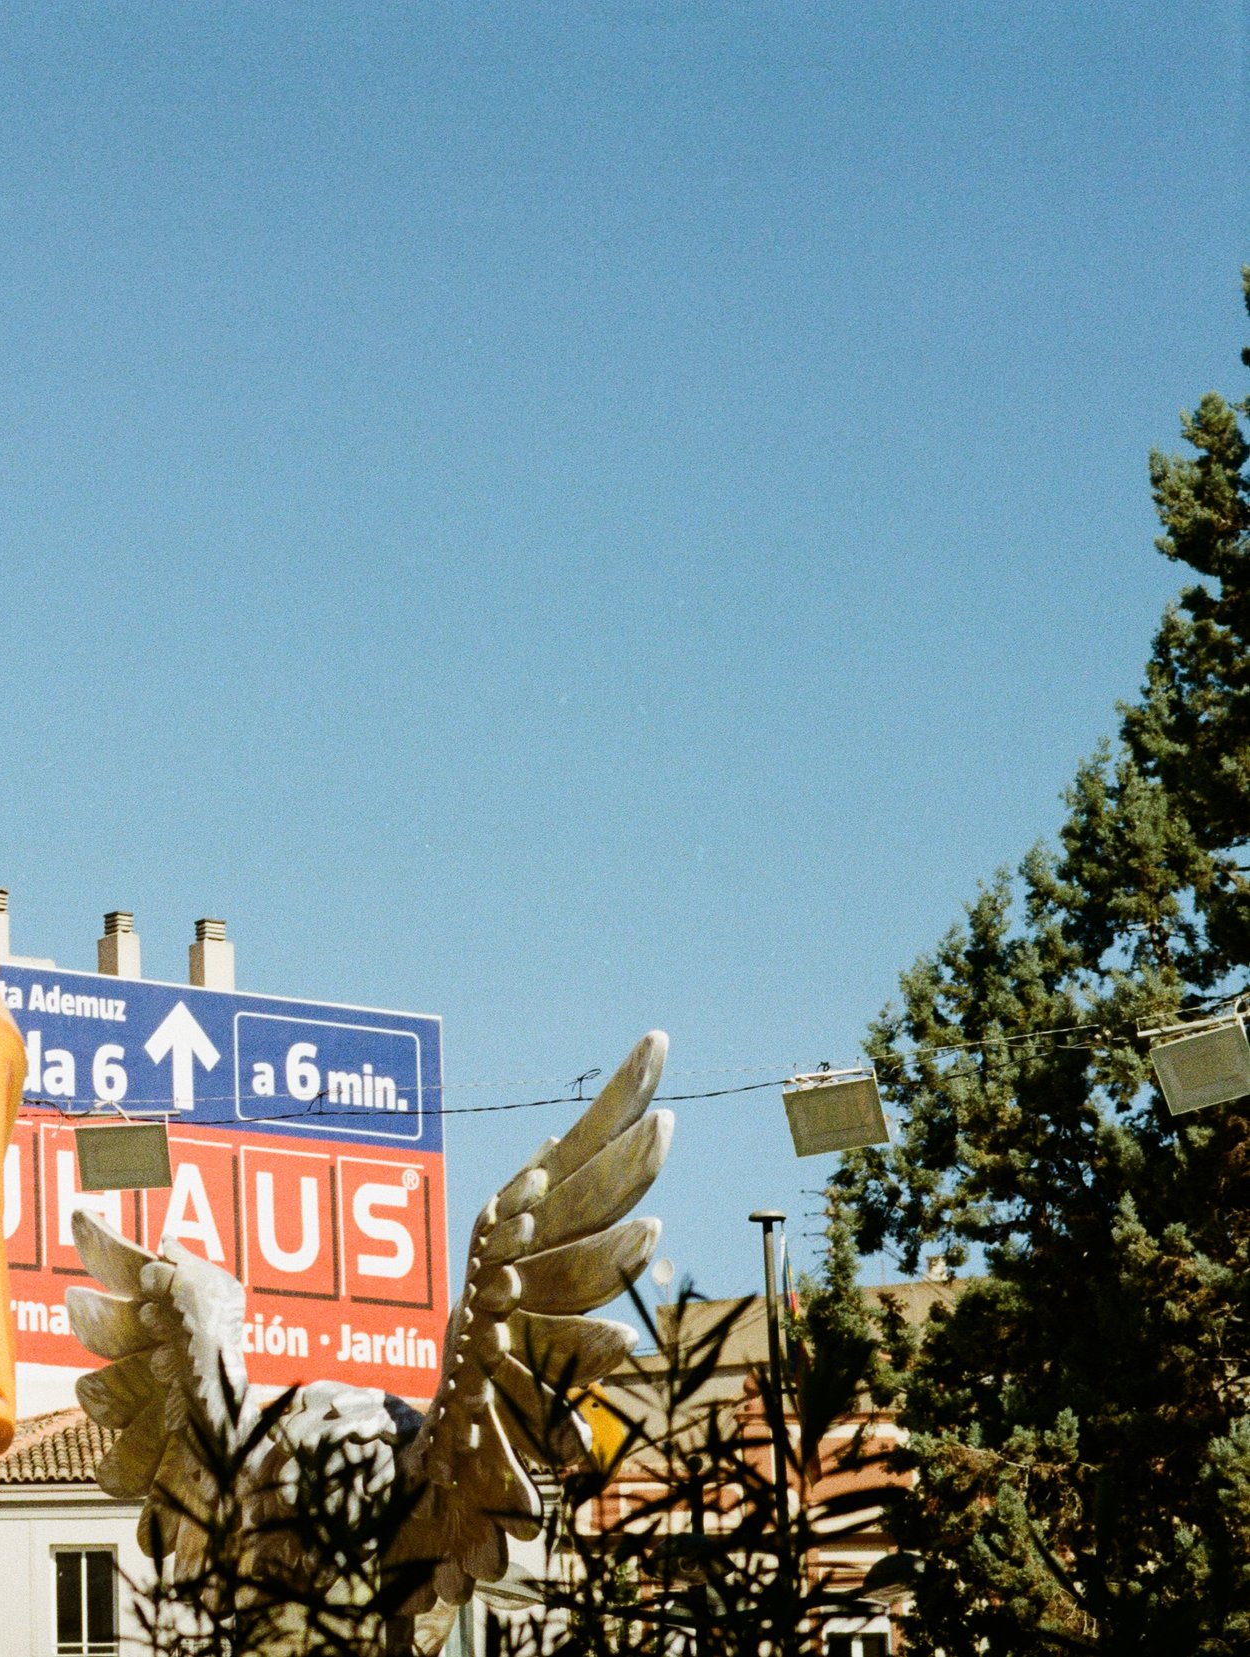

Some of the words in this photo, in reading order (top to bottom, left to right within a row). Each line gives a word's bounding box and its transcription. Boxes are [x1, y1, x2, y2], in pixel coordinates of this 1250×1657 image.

[28, 983, 127, 1022] Ademuz
[92, 1043, 128, 1102] 6
[252, 1062, 276, 1097] a
[285, 1042, 321, 1101] 6
[327, 1063, 409, 1112] min.
[336, 1323, 437, 1370] Jardín
